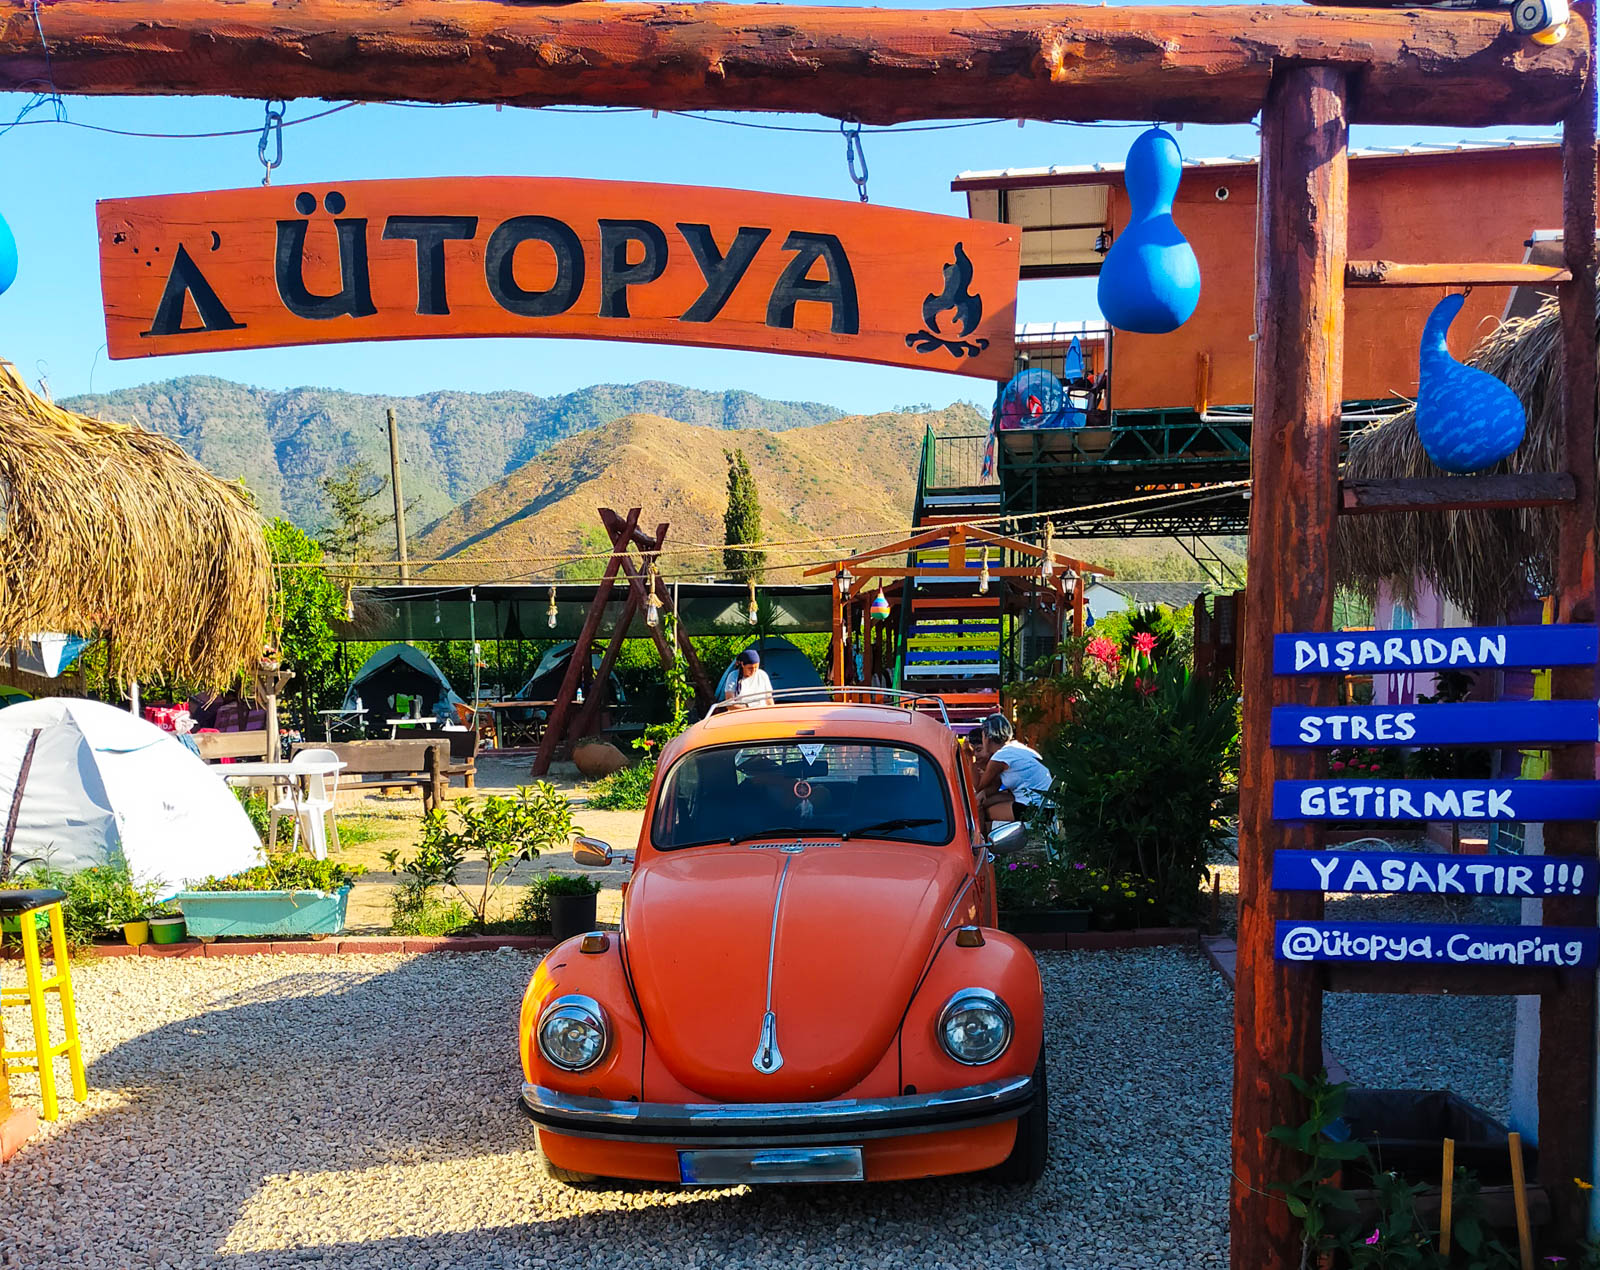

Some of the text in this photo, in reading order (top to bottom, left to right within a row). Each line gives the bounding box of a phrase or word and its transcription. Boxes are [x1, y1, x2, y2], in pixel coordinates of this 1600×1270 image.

[276, 191, 859, 335] ÜTOPYA
[1295, 635, 1506, 671] DIŞARIDAN
[1299, 713, 1416, 743] STRES
